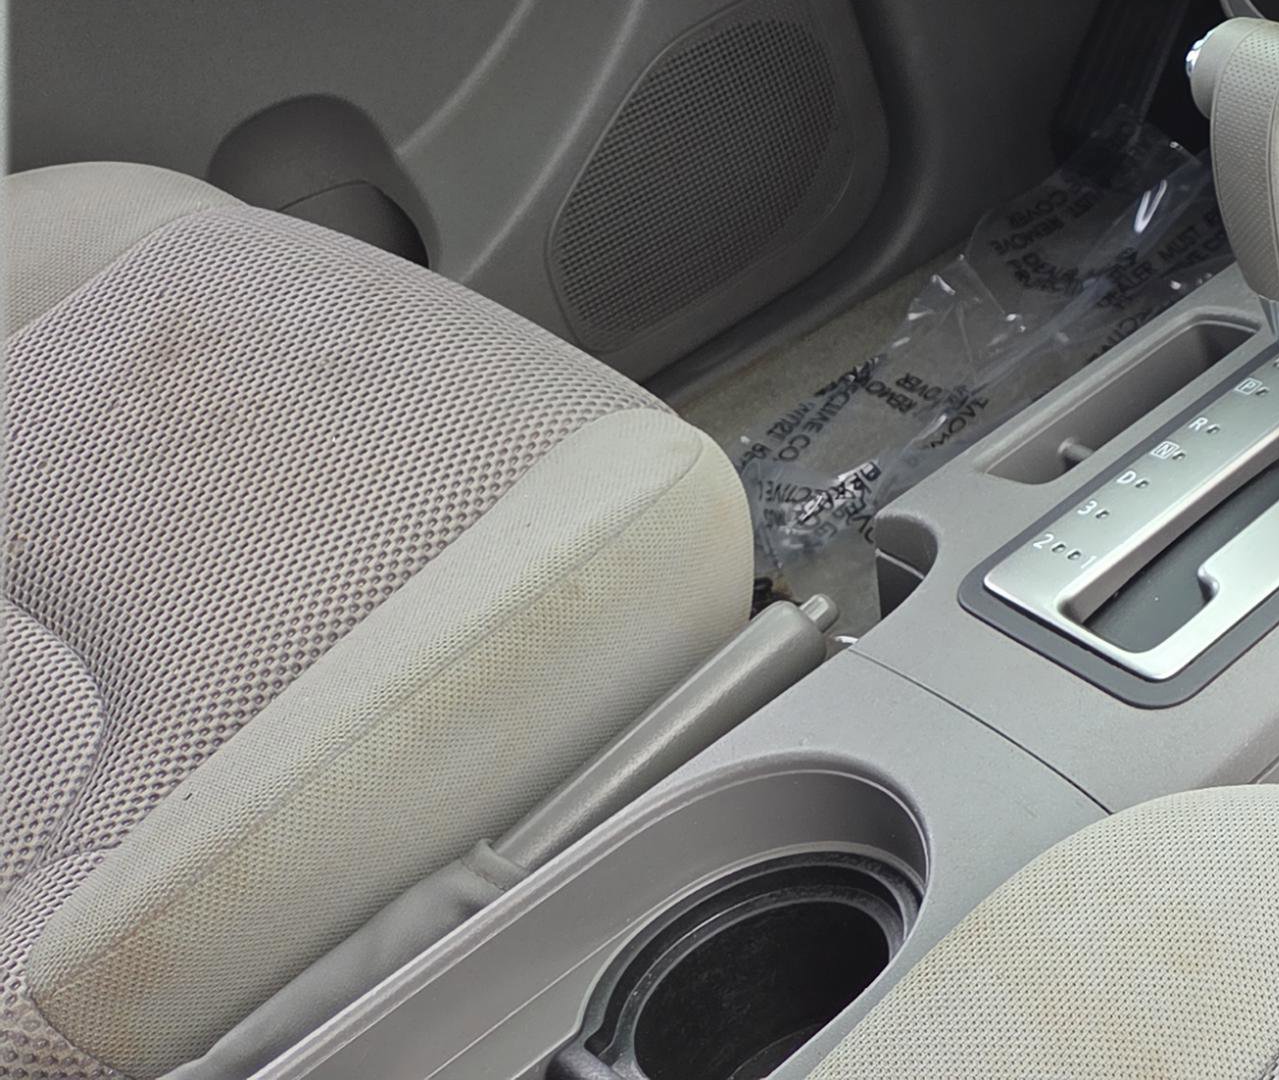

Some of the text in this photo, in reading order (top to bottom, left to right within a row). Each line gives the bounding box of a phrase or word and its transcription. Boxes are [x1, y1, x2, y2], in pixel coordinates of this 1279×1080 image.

[1188, 417, 1208, 432] R
[1116, 470, 1137, 485] D
[1077, 500, 1098, 516] 3
[1033, 533, 1055, 550] 2
